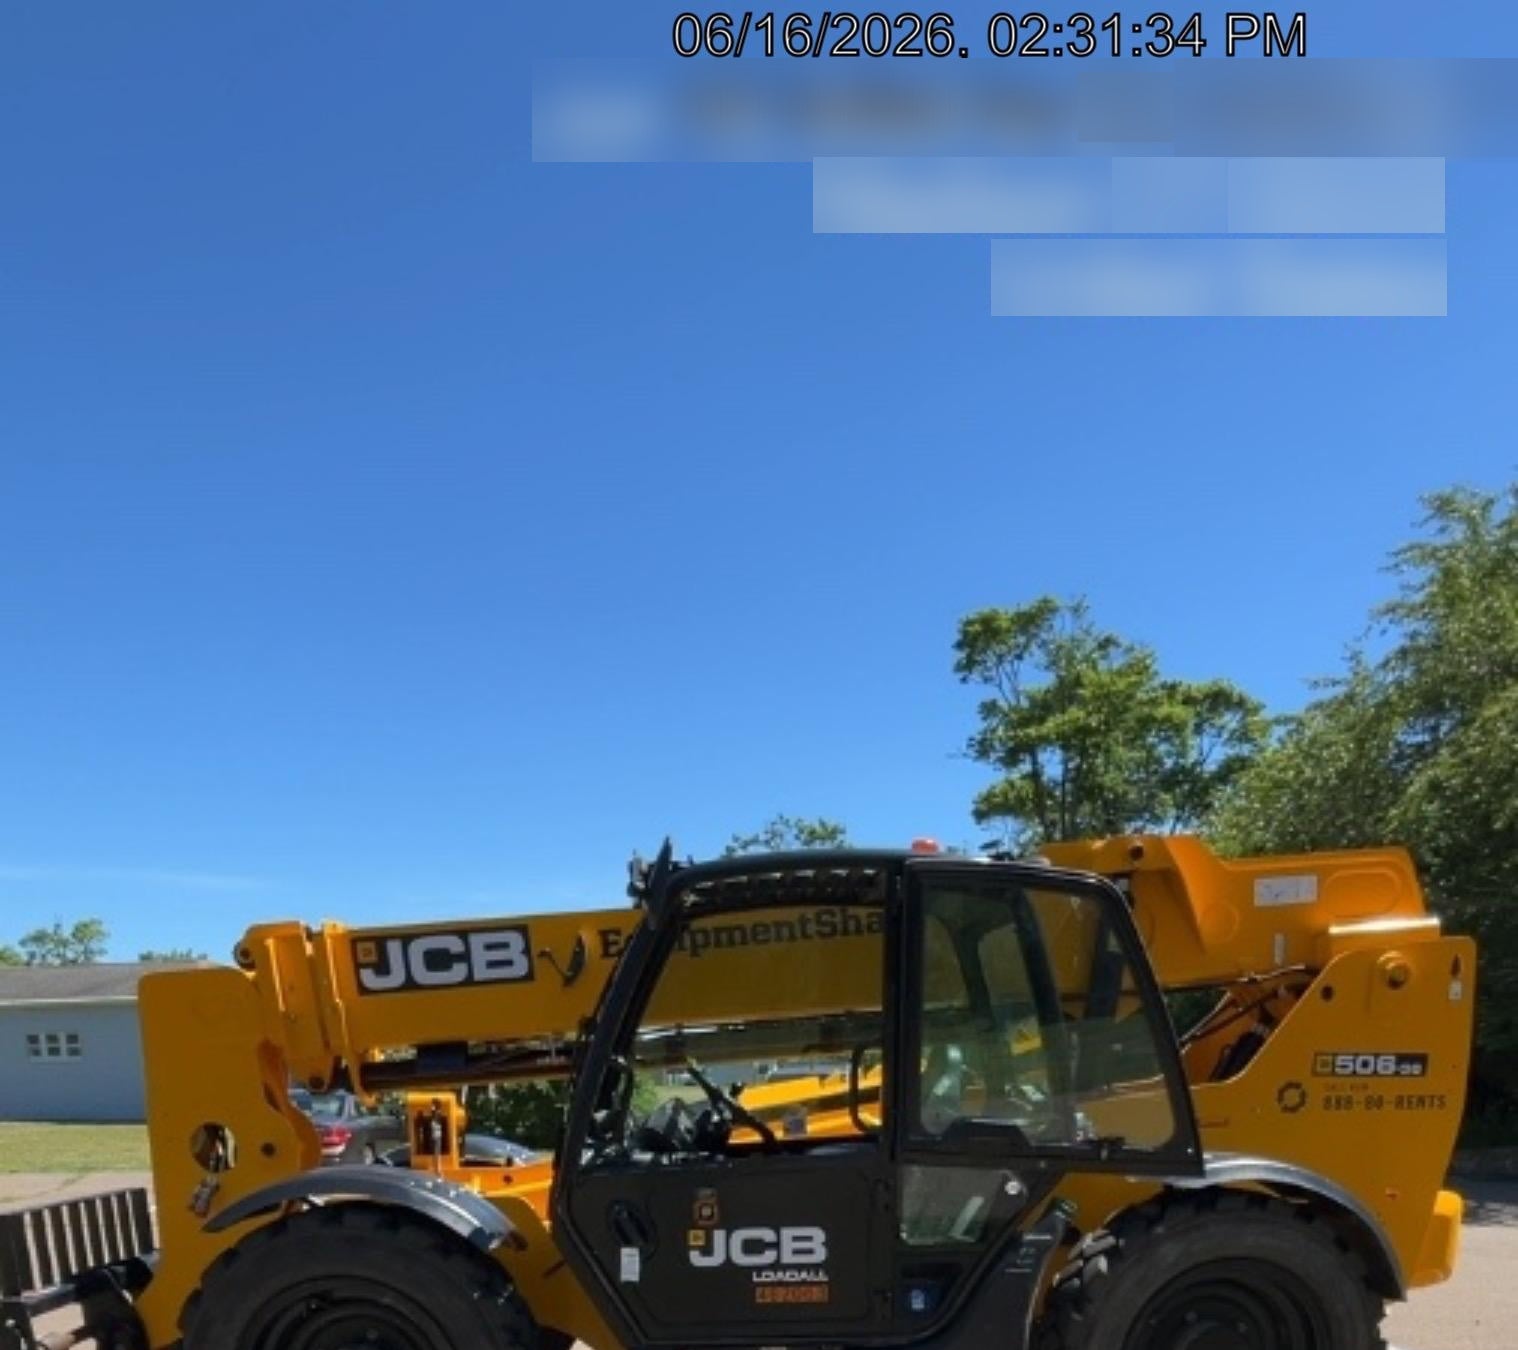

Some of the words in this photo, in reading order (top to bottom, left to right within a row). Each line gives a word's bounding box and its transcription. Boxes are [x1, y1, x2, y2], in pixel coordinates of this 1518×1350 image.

[597, 907, 884, 958] EipmentSha
[359, 929, 529, 991] JCB
[689, 1226, 828, 1267] JCB
[752, 1269, 829, 1283] LOADALL
